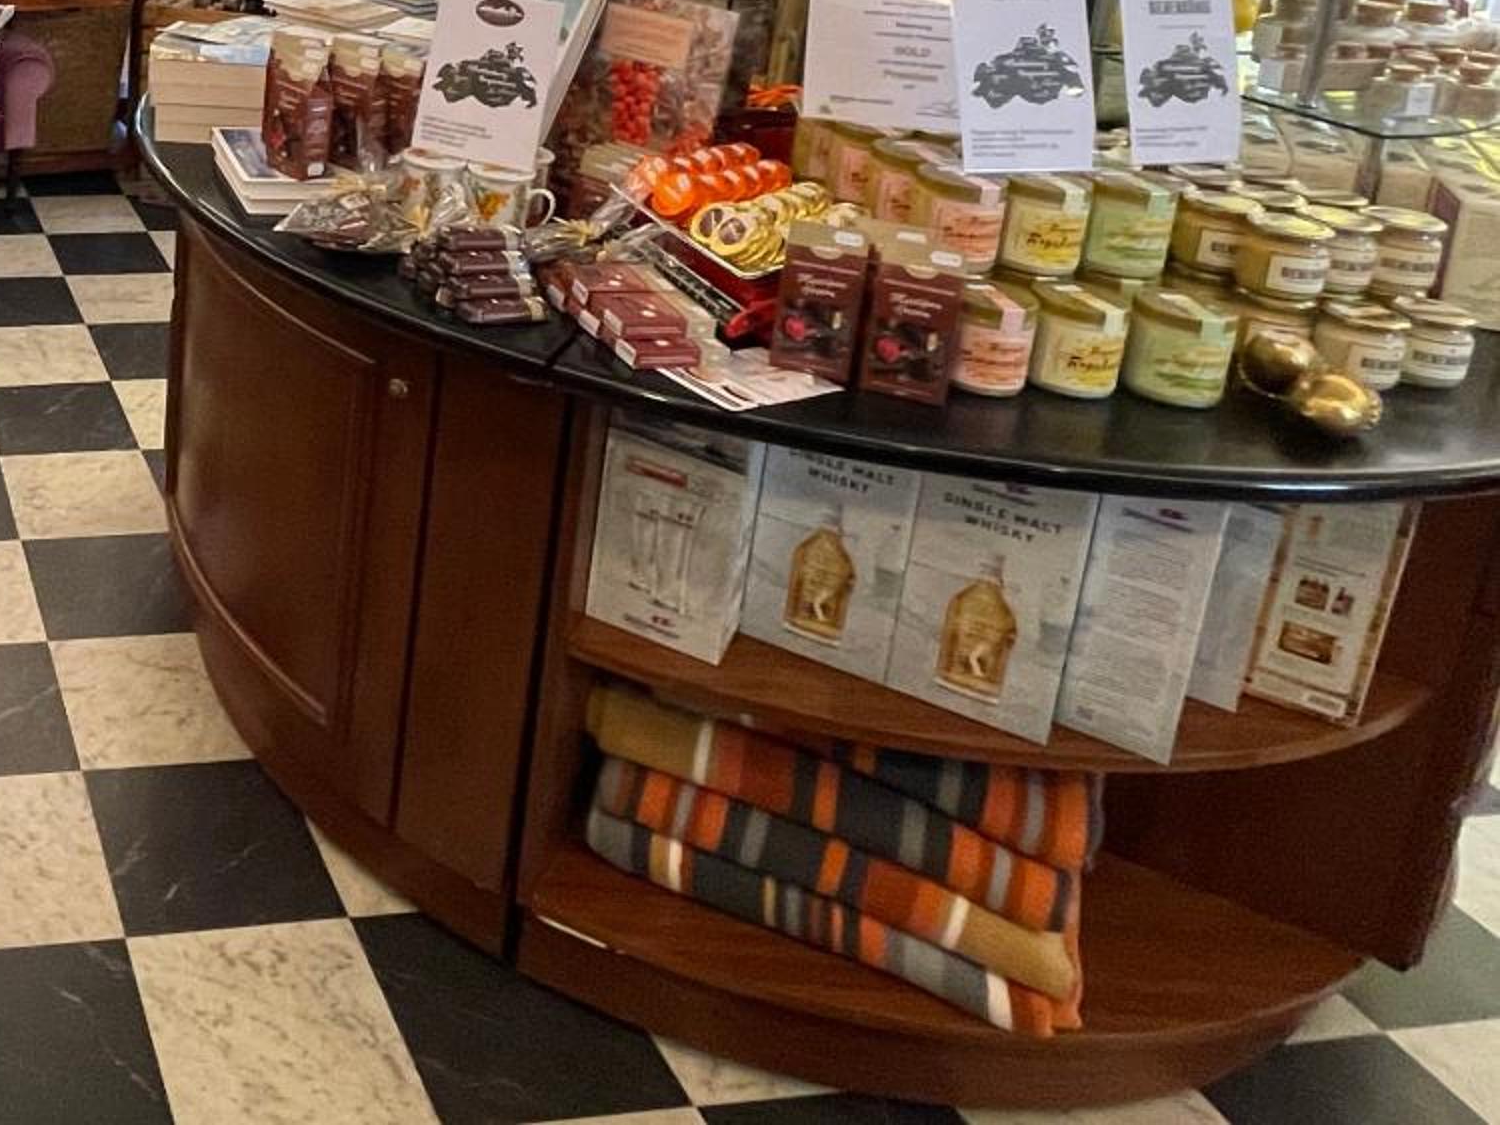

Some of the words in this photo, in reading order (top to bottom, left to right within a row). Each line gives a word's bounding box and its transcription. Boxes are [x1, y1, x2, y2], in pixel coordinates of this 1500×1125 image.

[808, 467, 869, 494] WHISKY
[852, 465, 895, 487] MALT
[943, 492, 1008, 520] SINGLE
[1013, 515, 1062, 535] MALT
[964, 516, 1035, 543] WHISKY
